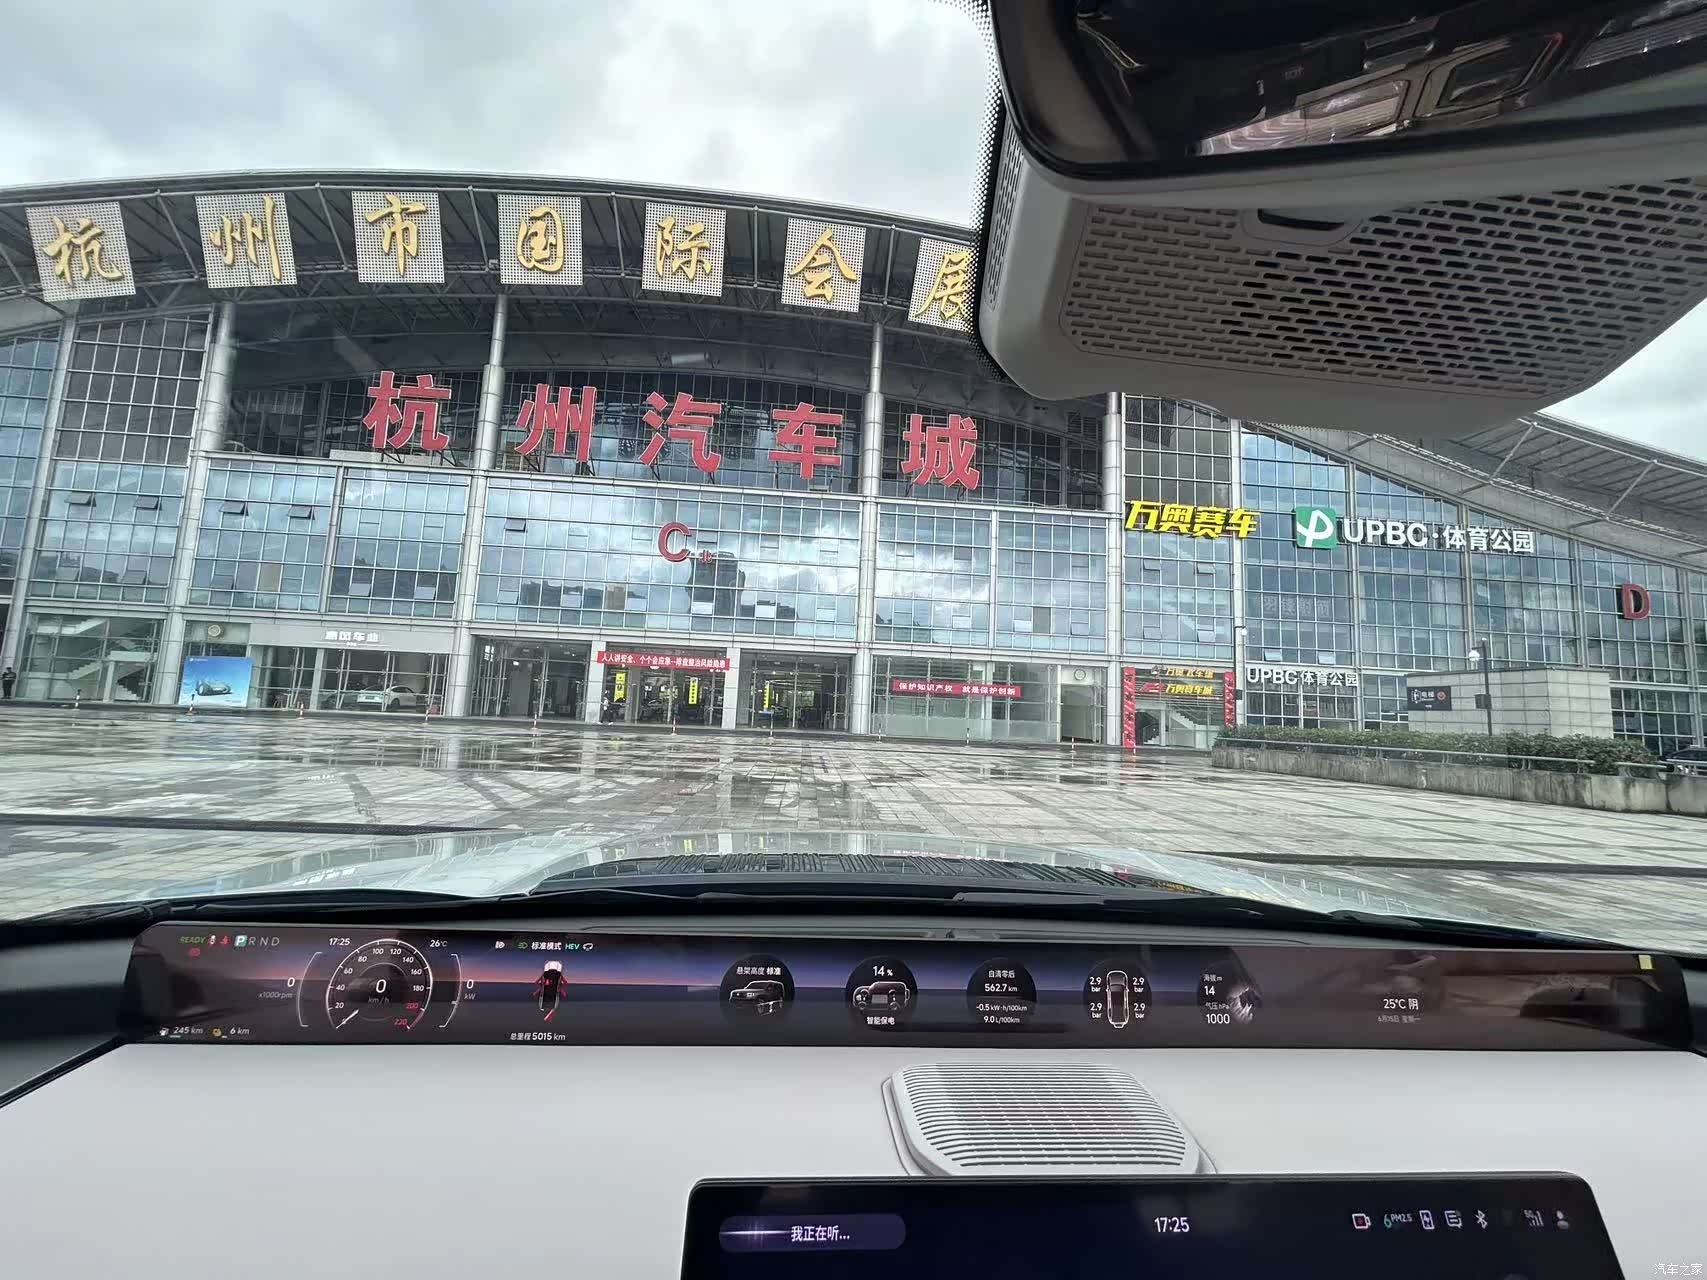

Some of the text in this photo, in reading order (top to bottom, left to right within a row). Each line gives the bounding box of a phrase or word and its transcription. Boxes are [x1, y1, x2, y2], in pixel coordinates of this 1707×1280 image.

[363, 370, 981, 491] 杭州汽车城
[1124, 499, 1258, 540] 万奥赛车
[659, 521, 691, 562] C
[1622, 583, 1651, 620] D
[899, 682, 1016, 696] 保护知识产权 就是保护创新
[248, 936, 257, 945] R
[259, 936, 268, 946] N
[270, 936, 280, 946] D
[329, 938, 351, 946] 17:25
[531, 941, 562, 950] 标准模式
[372, 947, 385, 955] 100
[343, 967, 353, 975] 60
[410, 968, 422, 976] 160
[872, 966, 885, 976] 14
[287, 977, 296, 988] 0
[466, 979, 475, 989] 0
[1089, 976, 1102, 985] 2.9
[1132, 976, 1145, 986] 2.9
[375, 979, 387, 993] 0
[984, 983, 1008, 992] 562.7
[1204, 985, 1216, 996] 14
[976, 1003, 990, 1011] -0.5
[1090, 1002, 1103, 1011] 2.9
[1133, 1002, 1146, 1012] 2.9
[1383, 998, 1419, 1010] 25°C 阴
[866, 1016, 896, 1025] 智能保电
[983, 1015, 995, 1023] 9.0
[1206, 1013, 1231, 1024] 1000
[173, 1026, 190, 1034] 245
[229, 1027, 236, 1035] 6
[532, 1032, 553, 1040] 5015
[1154, 1217, 1190, 1233] 17:25
[790, 1225, 850, 1242] 我正在听...
